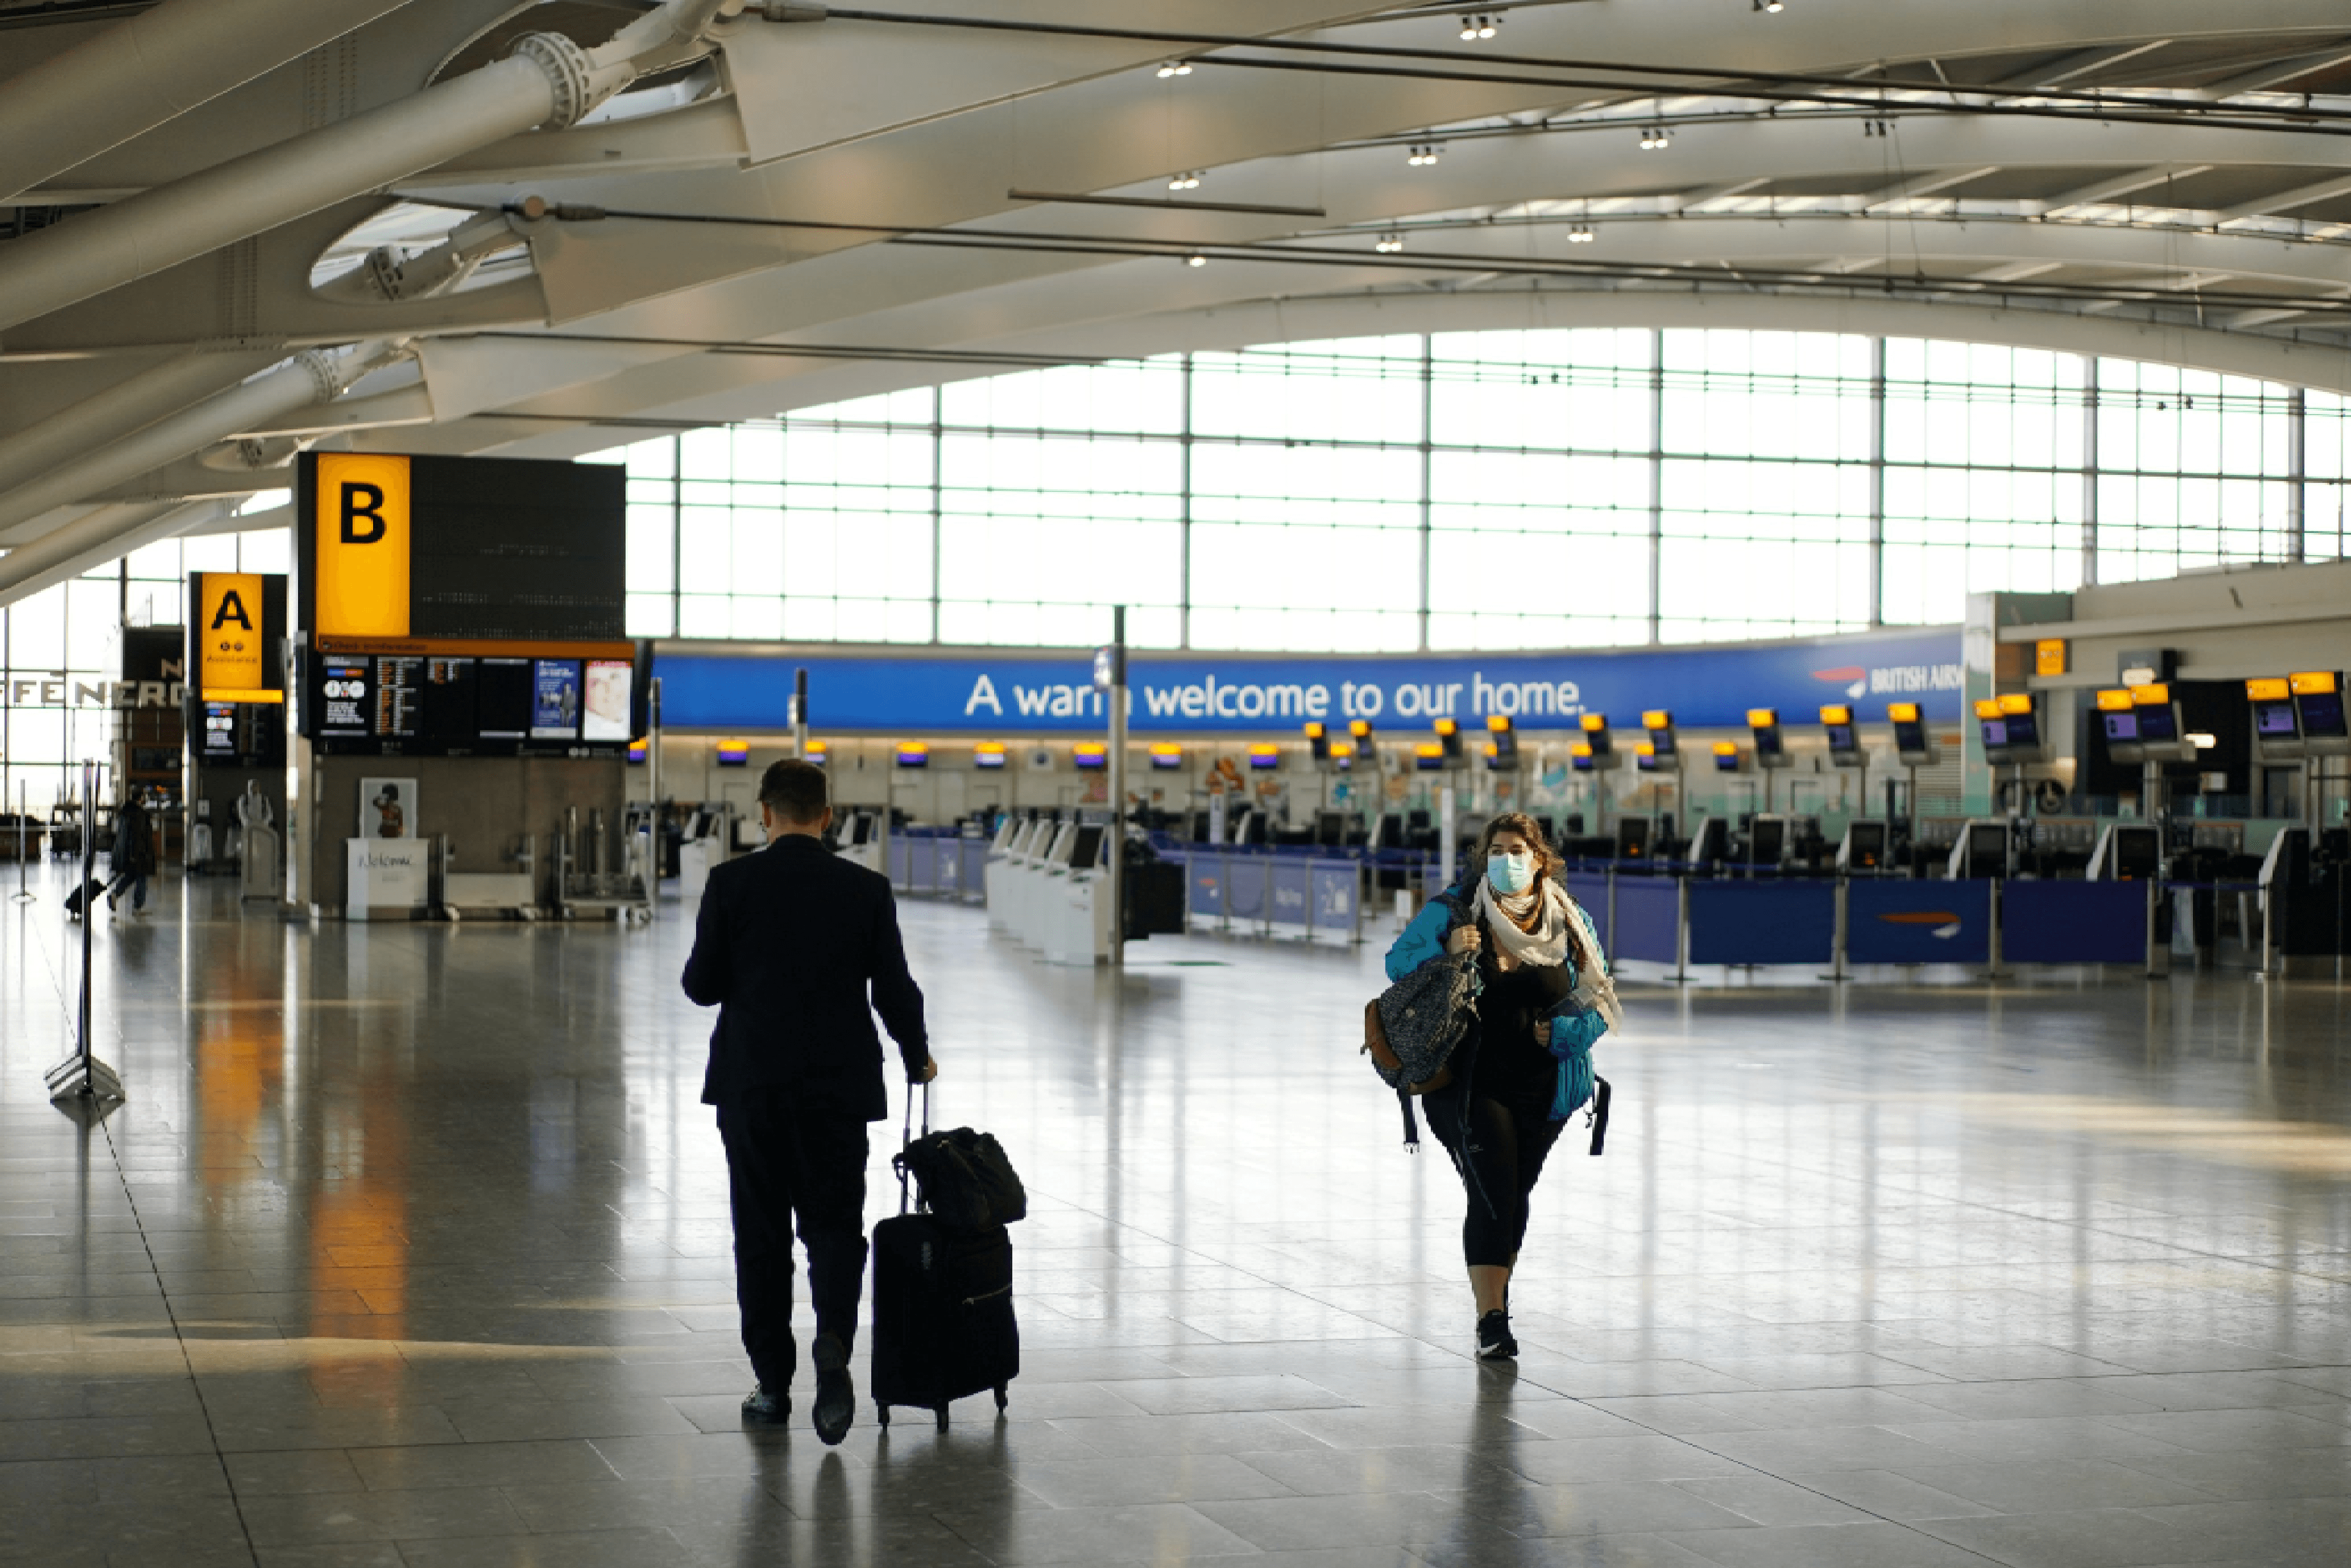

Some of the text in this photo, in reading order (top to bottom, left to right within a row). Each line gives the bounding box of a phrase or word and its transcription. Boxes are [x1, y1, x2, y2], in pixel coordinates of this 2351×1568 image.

[340, 481, 386, 544] B
[211, 590, 253, 631] A
[966, 673, 1003, 716] A
[1144, 674, 1331, 717] welcome
[1341, 681, 1384, 717] to
[1393, 683, 1464, 717] our
[1472, 671, 1587, 716] home.
[1870, 666, 1928, 694] BRITISH
